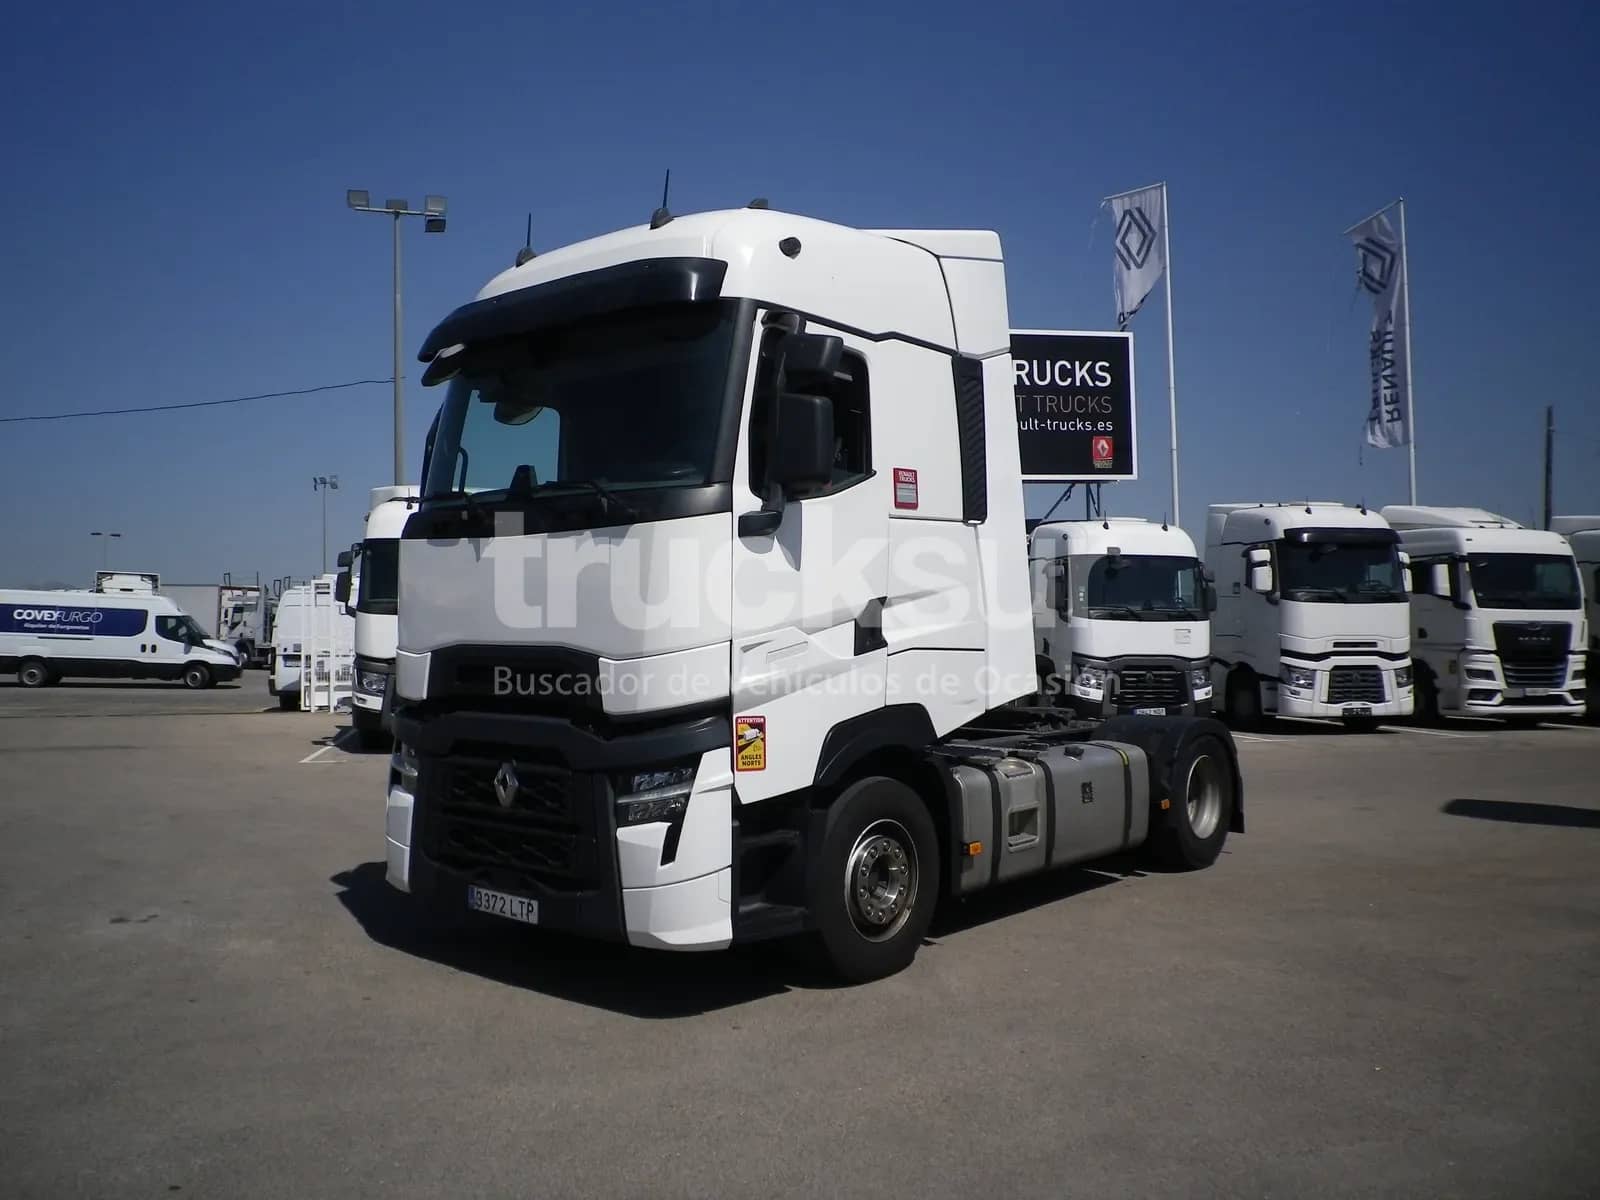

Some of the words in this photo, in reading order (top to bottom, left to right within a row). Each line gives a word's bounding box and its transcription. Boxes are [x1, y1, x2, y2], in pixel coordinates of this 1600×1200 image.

[1012, 359, 1112, 387] RUCKS
[1032, 395, 1113, 414] TRUCKS
[1020, 417, 1113, 431] ult-trucks.es
[510, 898, 534, 921] LTP
